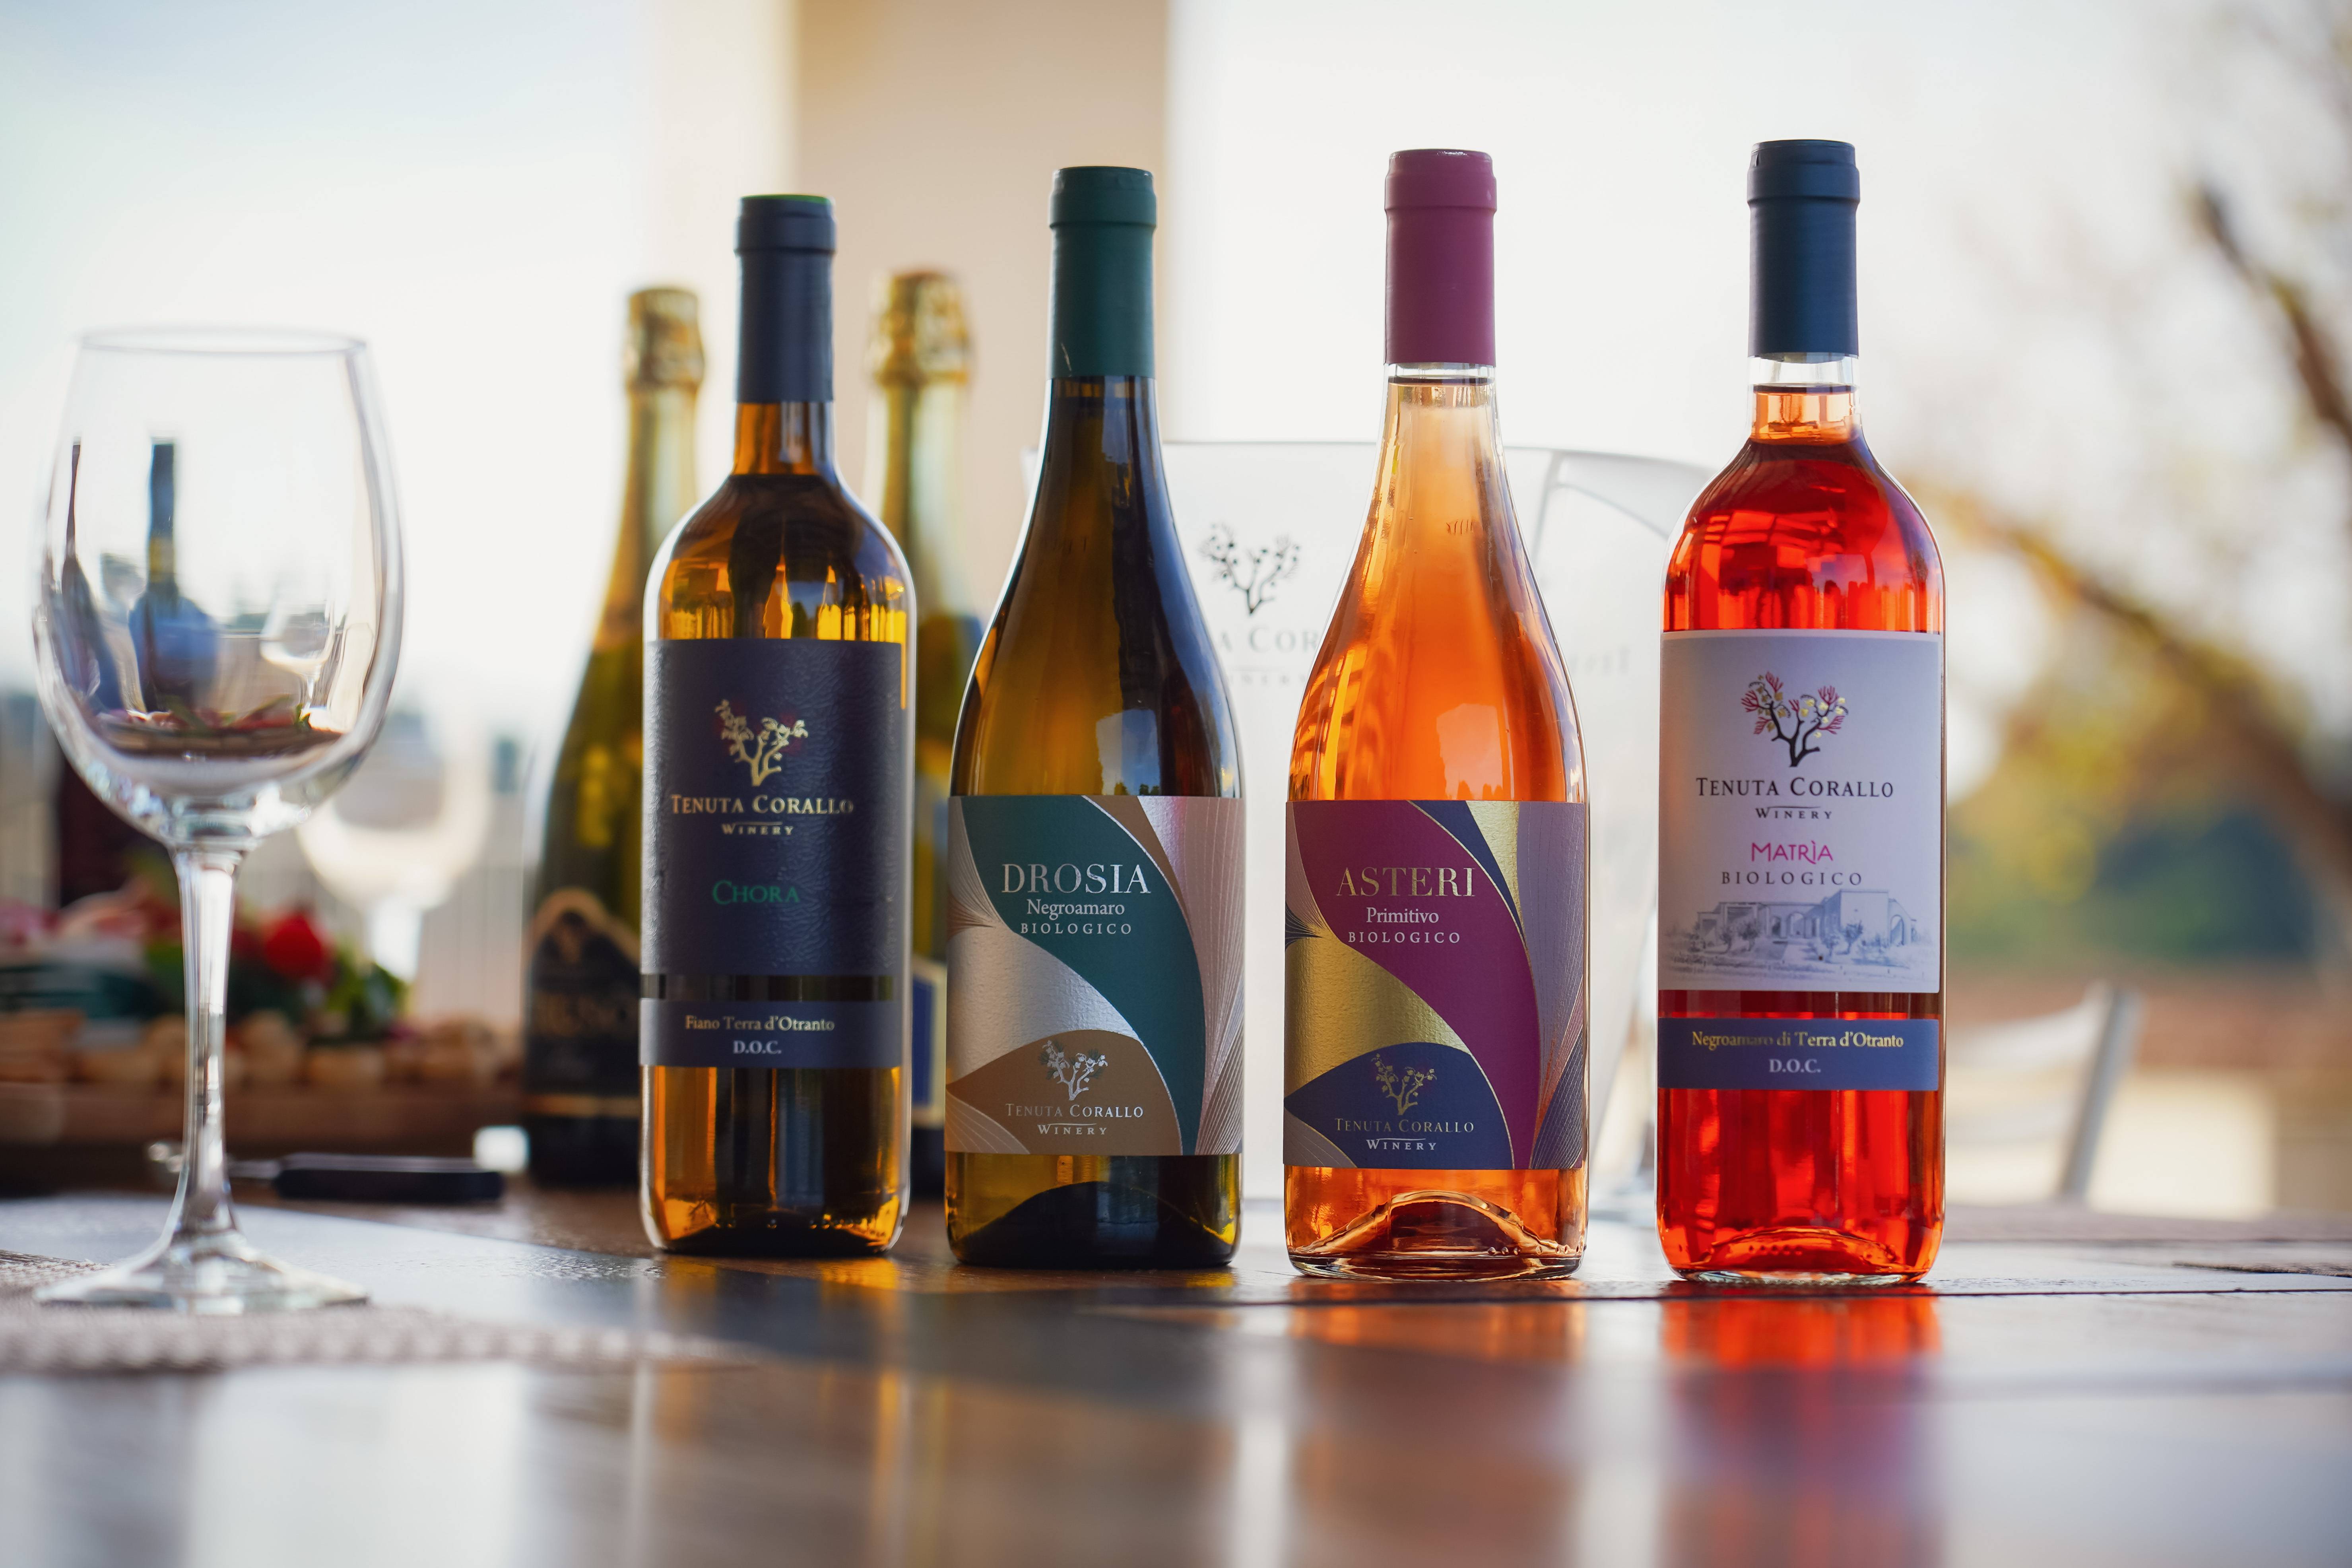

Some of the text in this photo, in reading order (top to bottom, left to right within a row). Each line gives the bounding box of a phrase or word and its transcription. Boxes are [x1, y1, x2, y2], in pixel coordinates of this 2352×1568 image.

[1696, 777, 1894, 798] TENUTA CORALLO
[671, 794, 854, 815] TENUTA CORALLO
[1755, 806, 1832, 819] WINERY
[721, 821, 794, 835] WINERY
[1001, 864, 1151, 894] DROSIA
[1335, 867, 1476, 897] ASTERI
[1721, 872, 1862, 885] BIOLOGICO
[712, 880, 801, 905] CHORA
[1027, 899, 1125, 920] Negroamaro
[1366, 907, 1439, 923] Primitivo
[1021, 923, 1132, 934] BIOLOGICO
[1348, 931, 1460, 943] BIOLOGICO
[685, 1015, 835, 1031] Fiano Terra d'Otranto
[733, 1040, 782, 1055] D.O.C.
[1692, 1030, 1904, 1051] Negroamaro di Terra d'Otranto
[1769, 1059, 1822, 1073] D.O.C.
[1005, 1103, 1144, 1118] TENUTA CORALLO
[1037, 1124, 1107, 1135] WINERY
[1335, 1118, 1475, 1133] TENUTA CORALLO
[1366, 1139, 1437, 1151] WINERY
